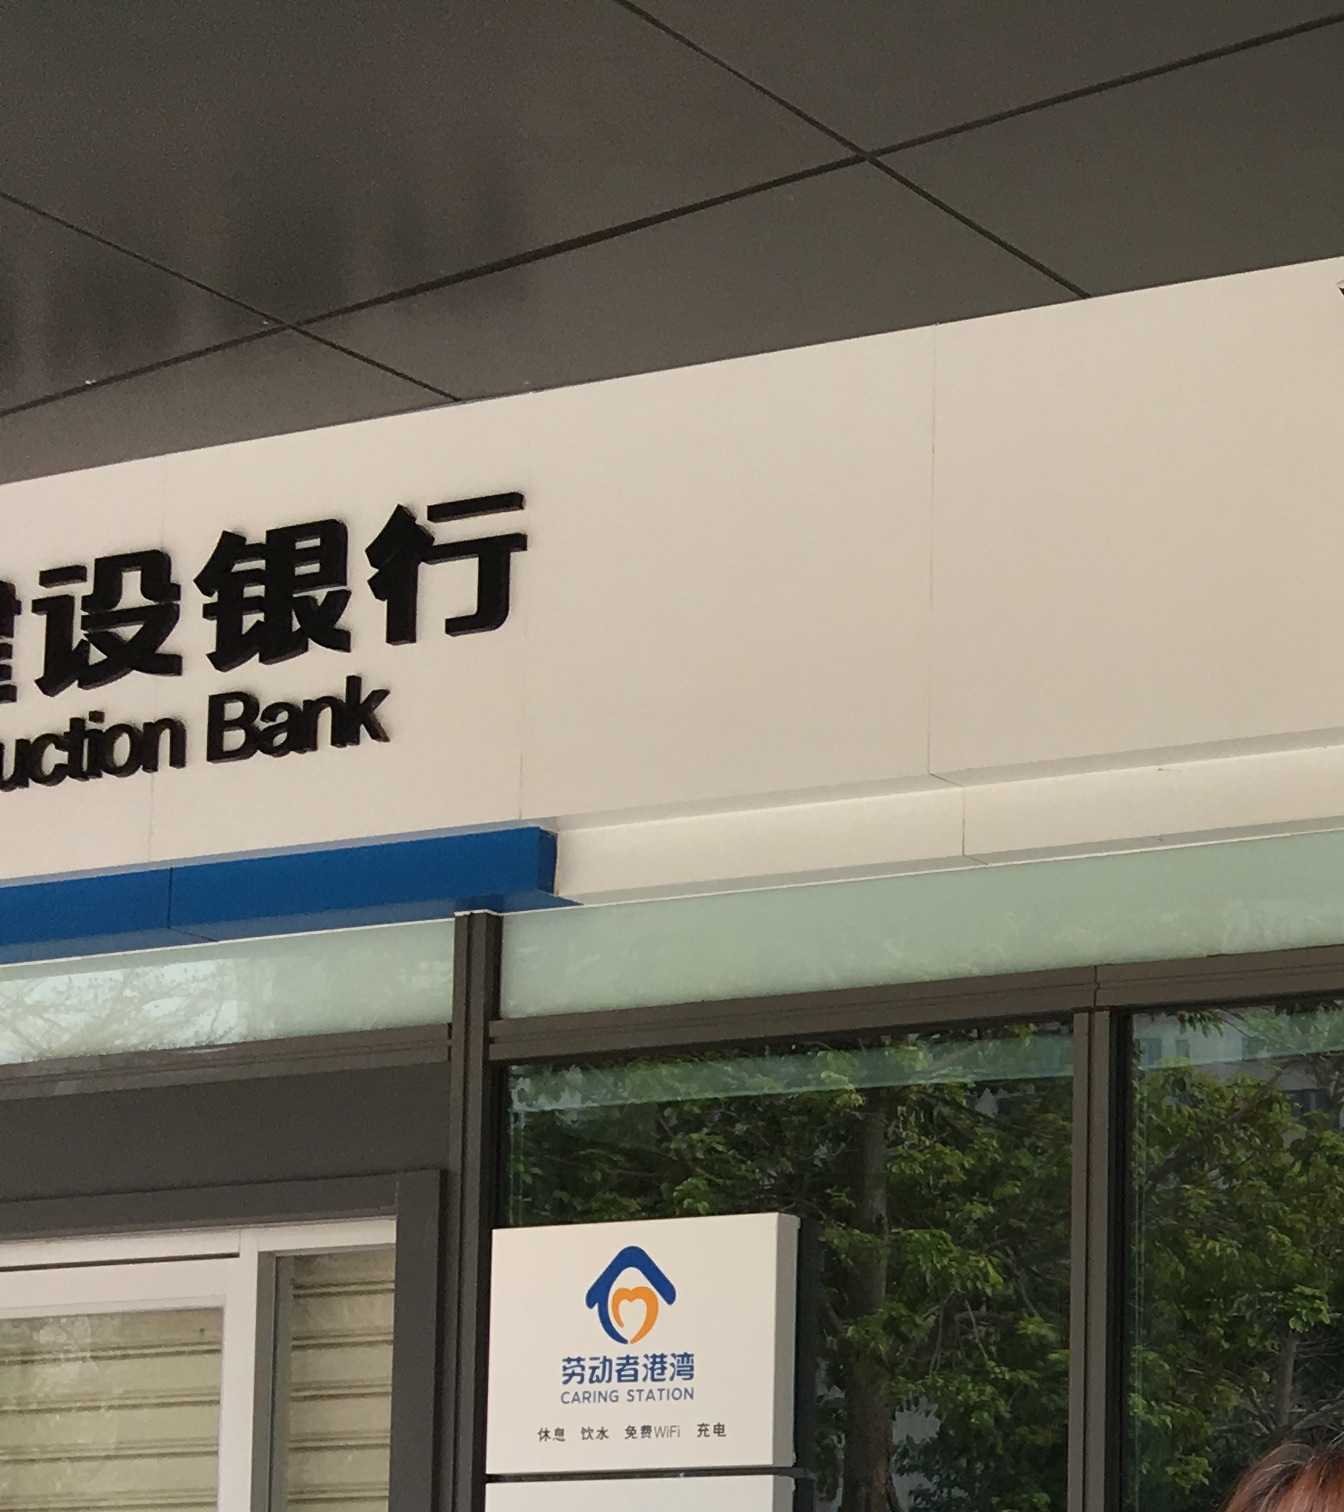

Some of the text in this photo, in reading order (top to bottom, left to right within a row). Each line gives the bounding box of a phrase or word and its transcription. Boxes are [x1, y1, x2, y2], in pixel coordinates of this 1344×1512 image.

[0, 491, 528, 704] 设银行
[206, 675, 392, 763] Bank
[561, 1352, 695, 1385] 劳动者港湾
[560, 1387, 695, 1405] CARING STATION
[537, 1427, 566, 1442] 休息
[580, 1426, 610, 1441] 饮水
[696, 1422, 727, 1438] 充电
